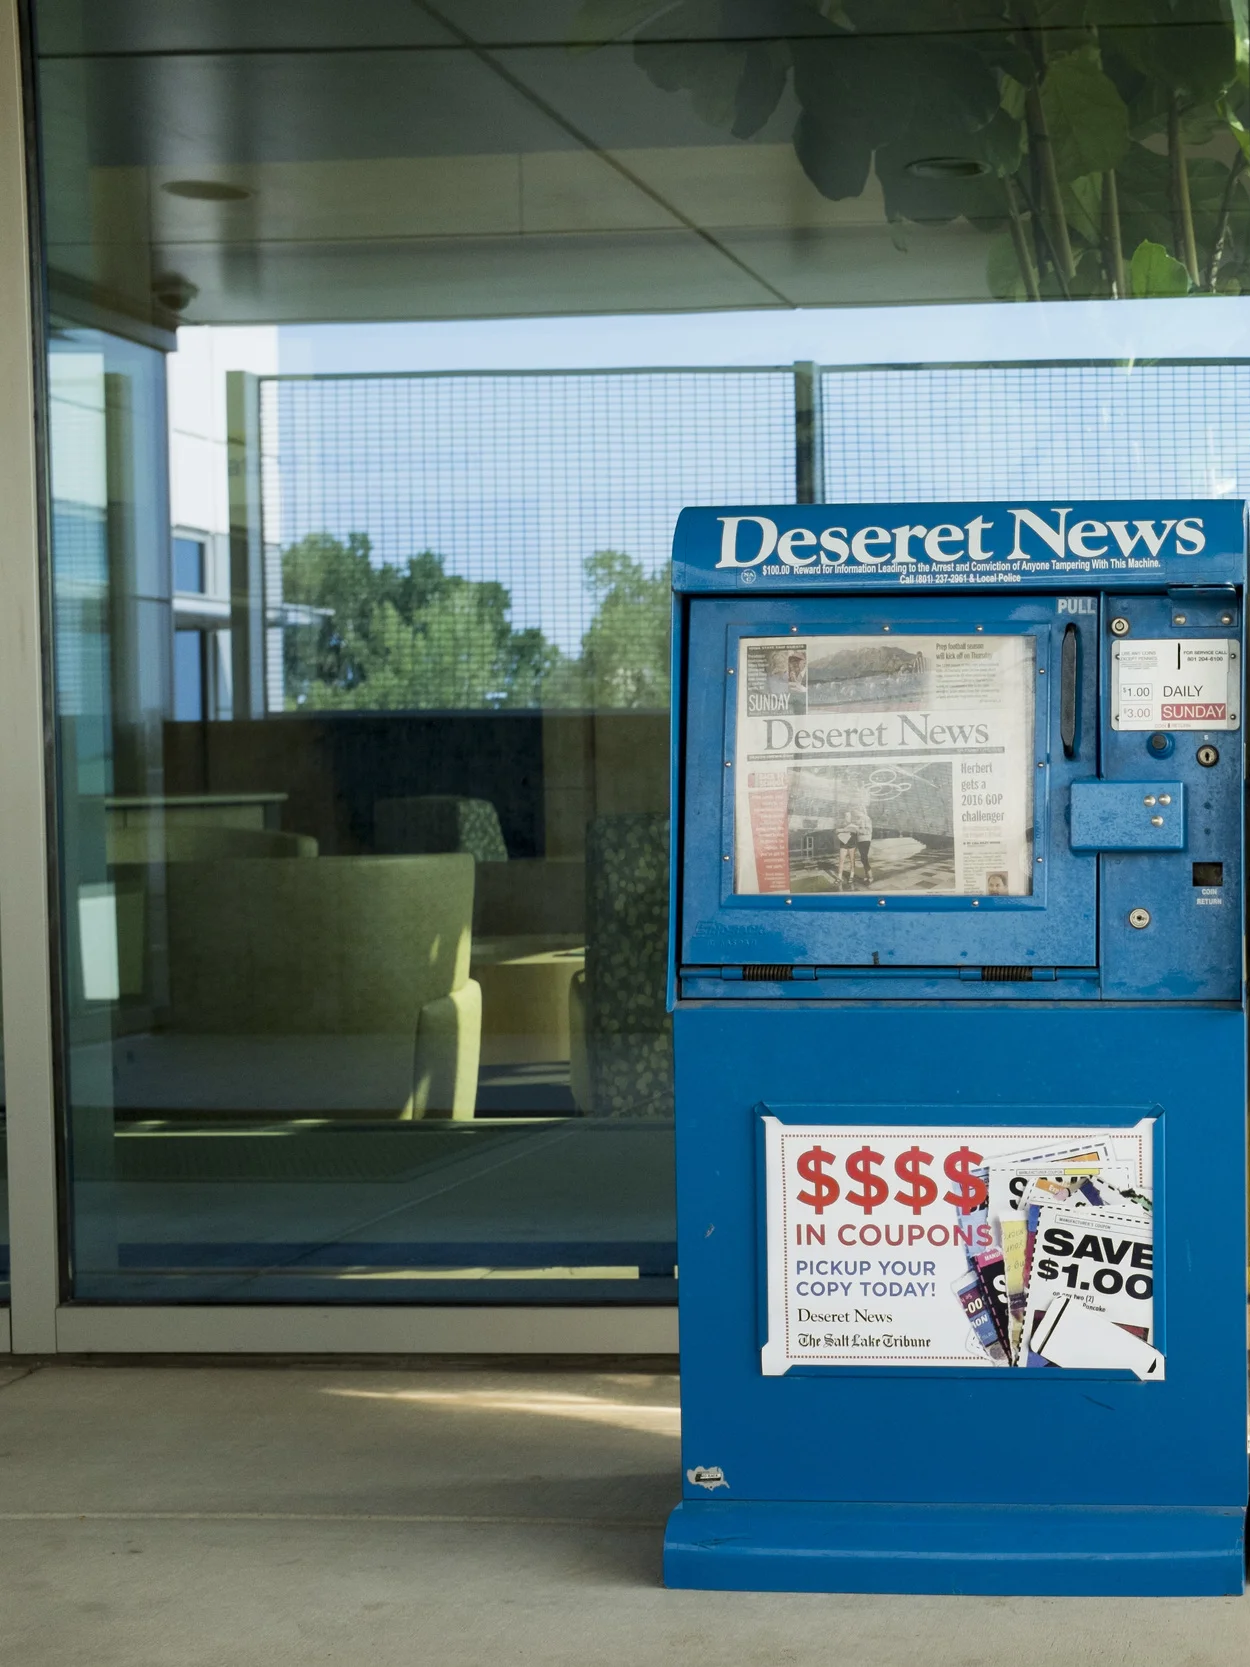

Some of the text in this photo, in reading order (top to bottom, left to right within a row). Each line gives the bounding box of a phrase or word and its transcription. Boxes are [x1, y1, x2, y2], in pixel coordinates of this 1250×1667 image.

[715, 508, 1206, 568] Deseret News
[762, 557, 1161, 576] $100.00 Reward for Information Leading to the Arrest and Conviction of Anyone Tampering With This Machine.
[900, 572, 1021, 585] Call (801) 237-2961 & Local Police
[1057, 598, 1096, 614] PULL
[1123, 685, 1203, 697] $1.00 DAILY
[748, 693, 791, 712] SUNDAY
[1123, 705, 1225, 718] $3.00 SUNDAY
[762, 713, 990, 750] Deseret News
[961, 763, 992, 774] Herbert
[961, 779, 986, 792] gets a
[961, 793, 1004, 806] 2016 GOP
[961, 810, 1005, 823] challenger
[796, 1145, 988, 1216] $$$$
[796, 1223, 994, 1247] IN COUPONS
[1042, 1228, 1153, 1270] SAVE
[796, 1260, 936, 1276] PICKUP YOUR
[1037, 1258, 1153, 1300] $1.00
[796, 1281, 936, 1297] COPY TODAY!
[797, 1308, 893, 1323] Deseret News
[1082, 1303, 1106, 1313] Pancake
[797, 1333, 931, 1348] The Salt Lake Tribune
